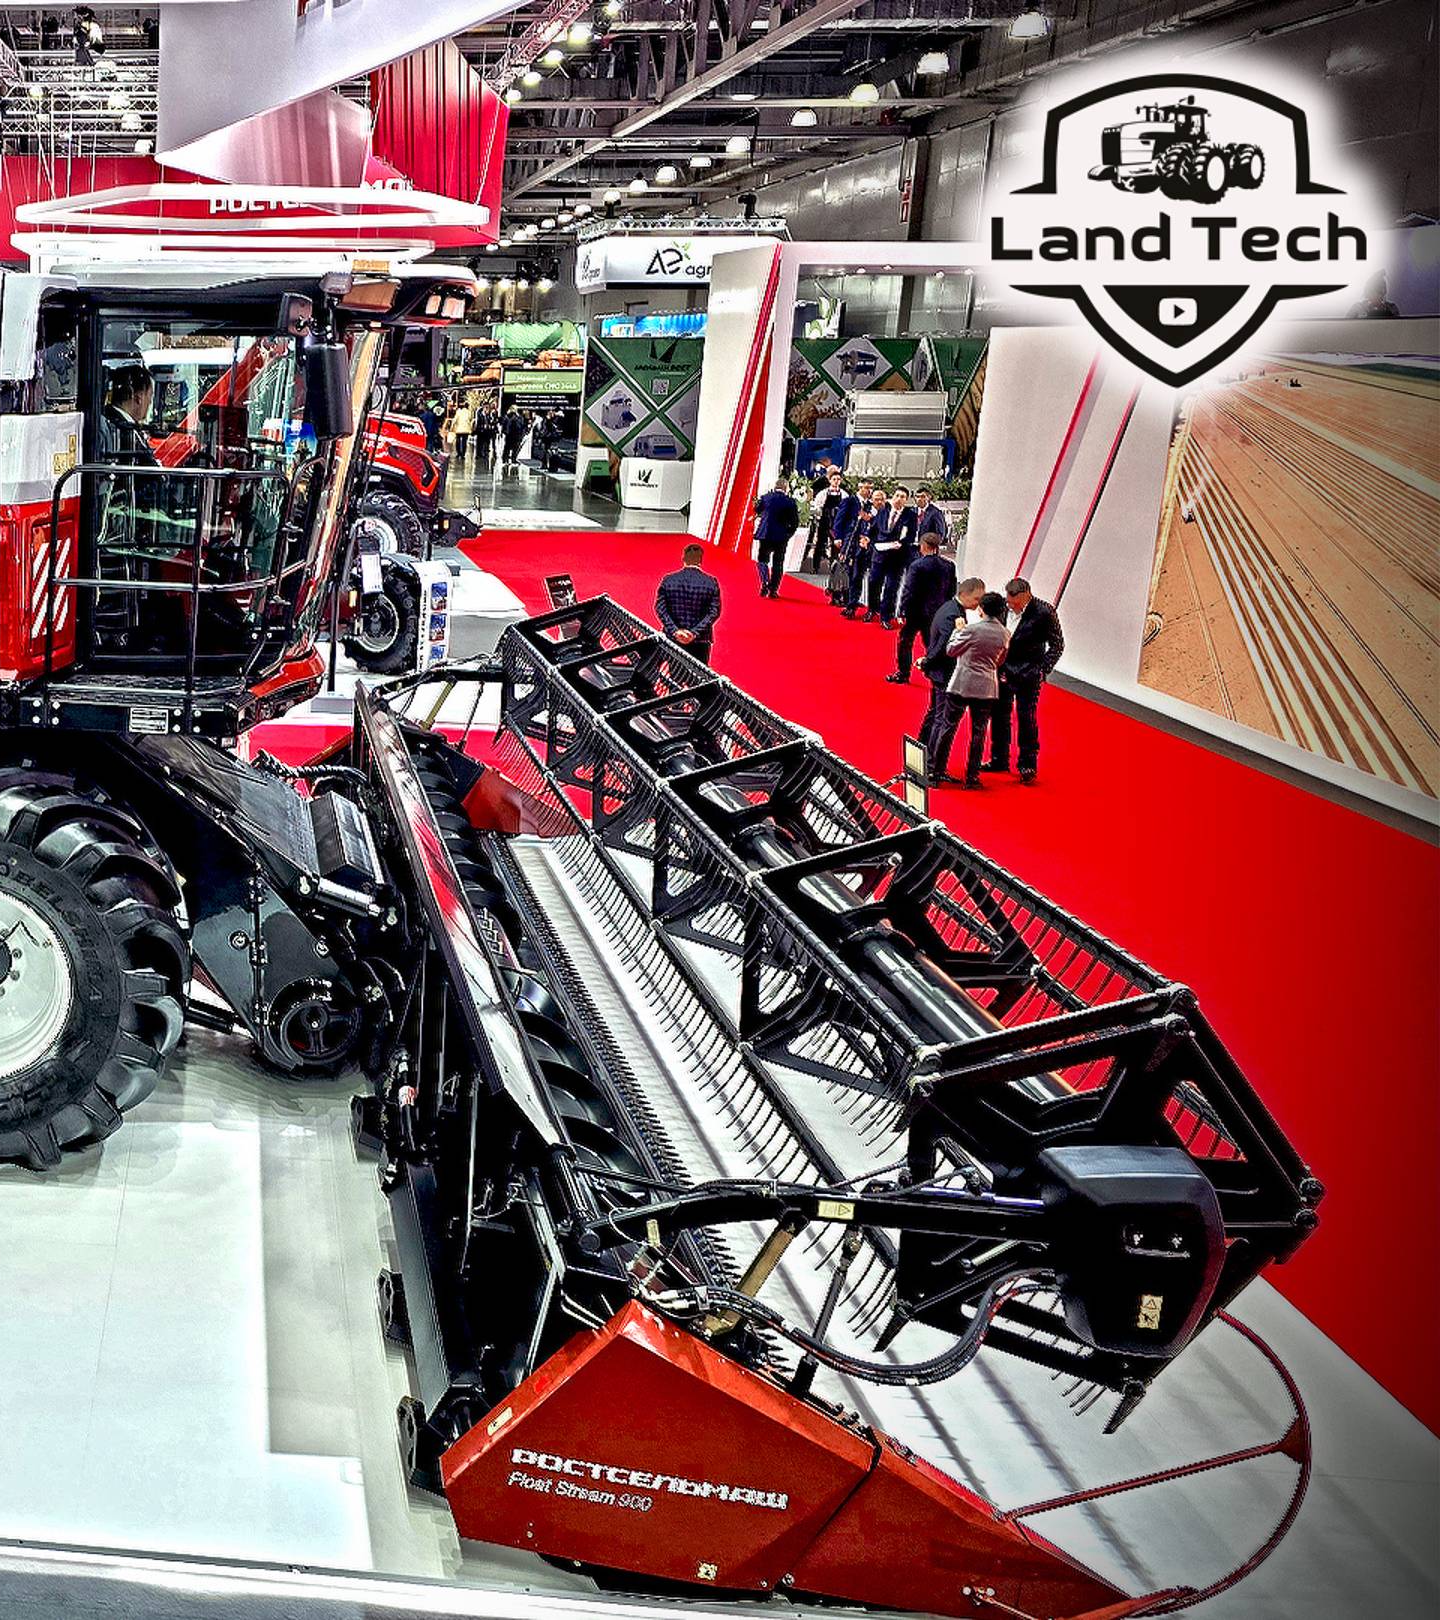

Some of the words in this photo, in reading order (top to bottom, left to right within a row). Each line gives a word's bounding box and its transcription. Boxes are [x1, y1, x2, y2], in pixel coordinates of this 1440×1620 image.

[685, 265, 712, 279] agr
[508, 1471, 550, 1494] Float
[554, 1480, 616, 1506] Stream
[618, 1493, 654, 1512] 900
[511, 1448, 789, 1511] РОСТСЕЛЬМАШ
